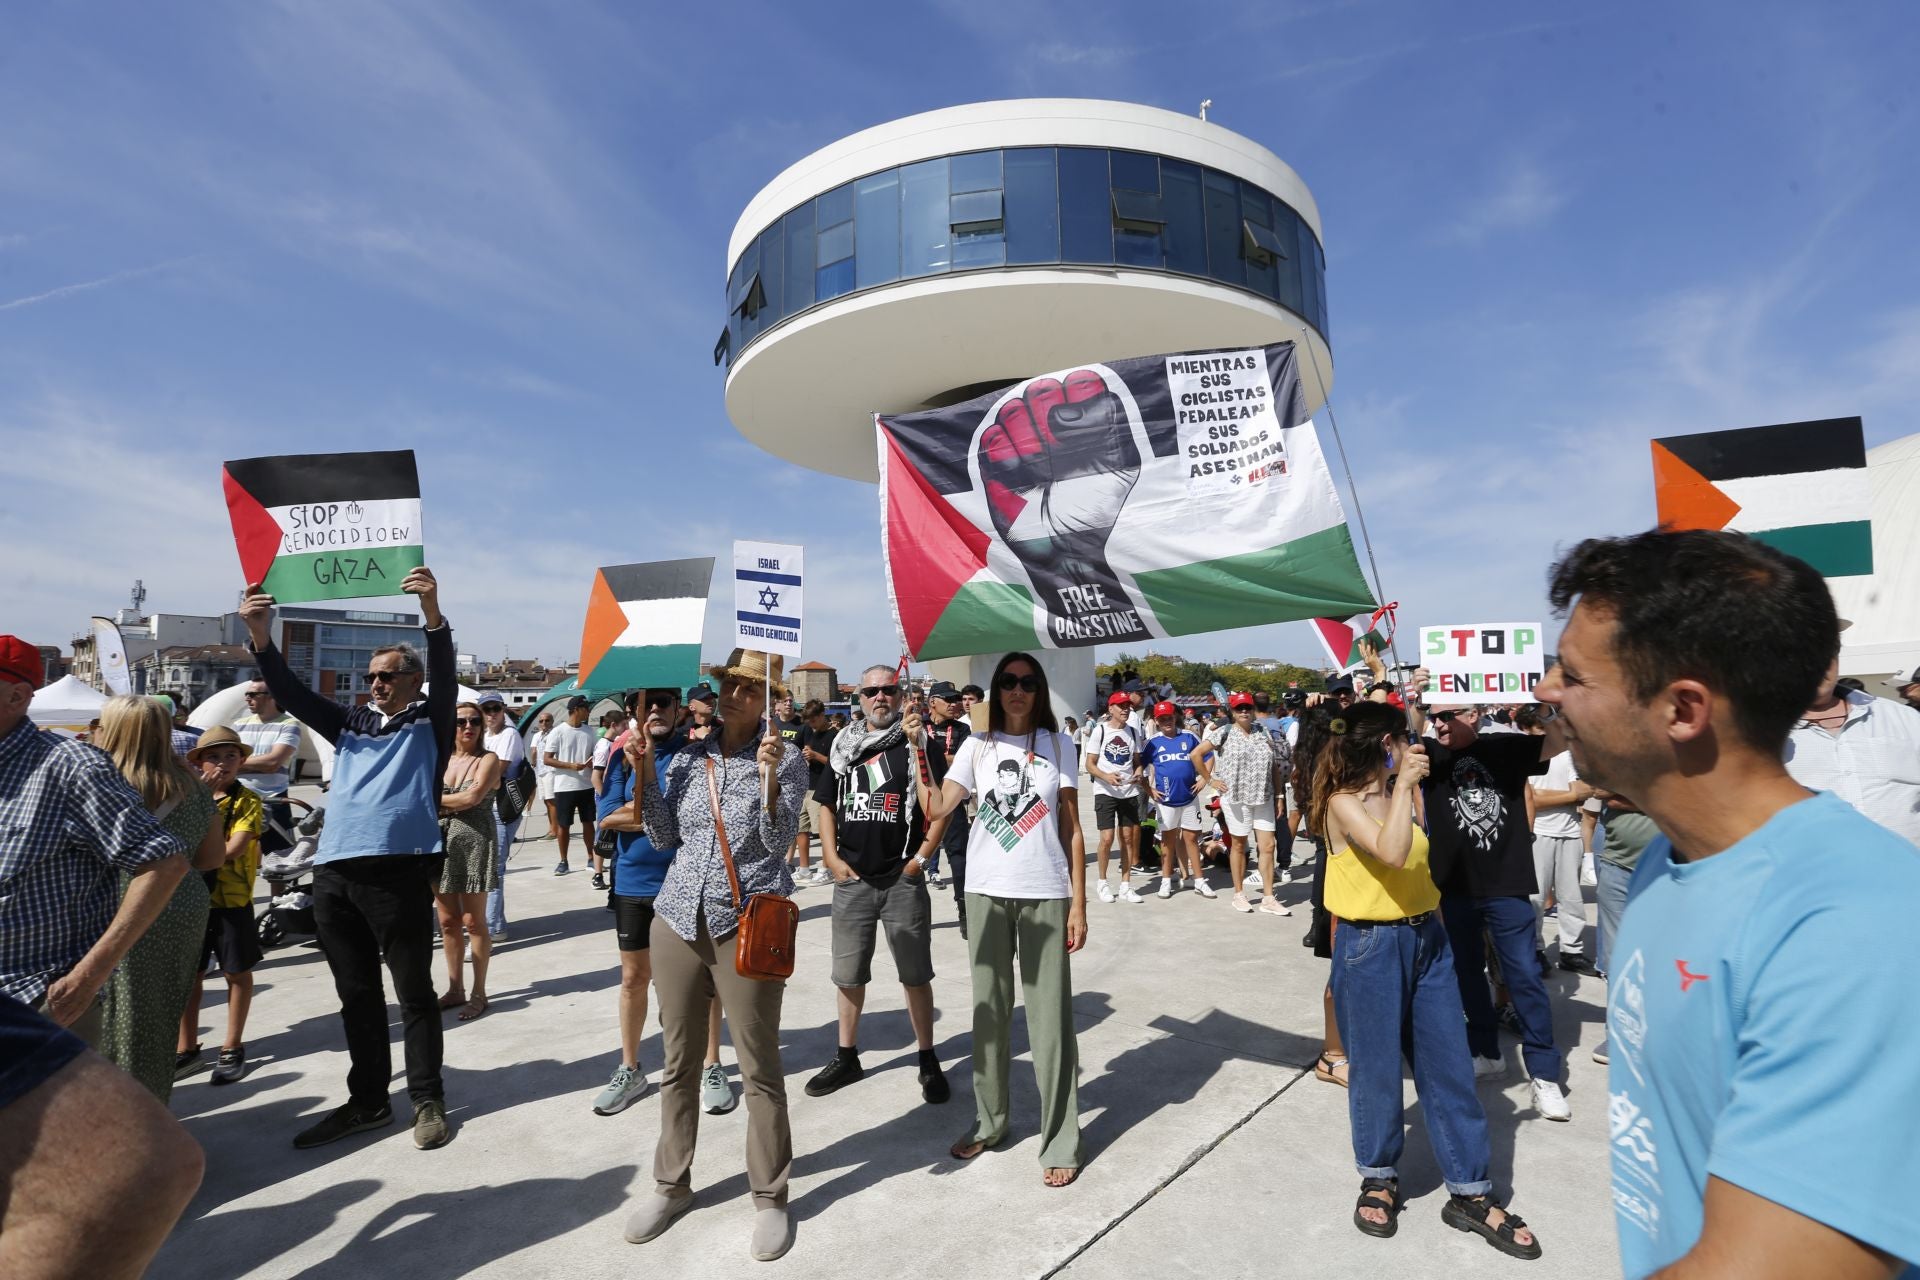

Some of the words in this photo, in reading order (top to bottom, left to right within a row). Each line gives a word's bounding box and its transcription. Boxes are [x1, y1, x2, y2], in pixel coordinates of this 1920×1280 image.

[1171, 356, 1257, 374] MIENTRAS
[1200, 373, 1231, 388] SUS
[1181, 386, 1266, 406] CICLISTAS
[1179, 403, 1265, 424] PEDALEAN
[1208, 424, 1239, 439] SUS
[1188, 430, 1269, 458] SOLDADOS
[1190, 441, 1284, 478] ASESINAN
[284, 527, 387, 553] GENOCIDIO
[392, 527, 410, 540] EN
[314, 557, 386, 585] GAZA
[758, 558, 780, 570] ISRAEL
[1057, 583, 1111, 614] FREE
[740, 624, 765, 638] ESTADO
[765, 627, 798, 643] GENOCIDA
[1055, 609, 1143, 640] PALESTINE
[1427, 629, 1535, 657] STOP
[845, 792, 900, 812] FREE
[845, 811, 897, 823] PALESTINE
